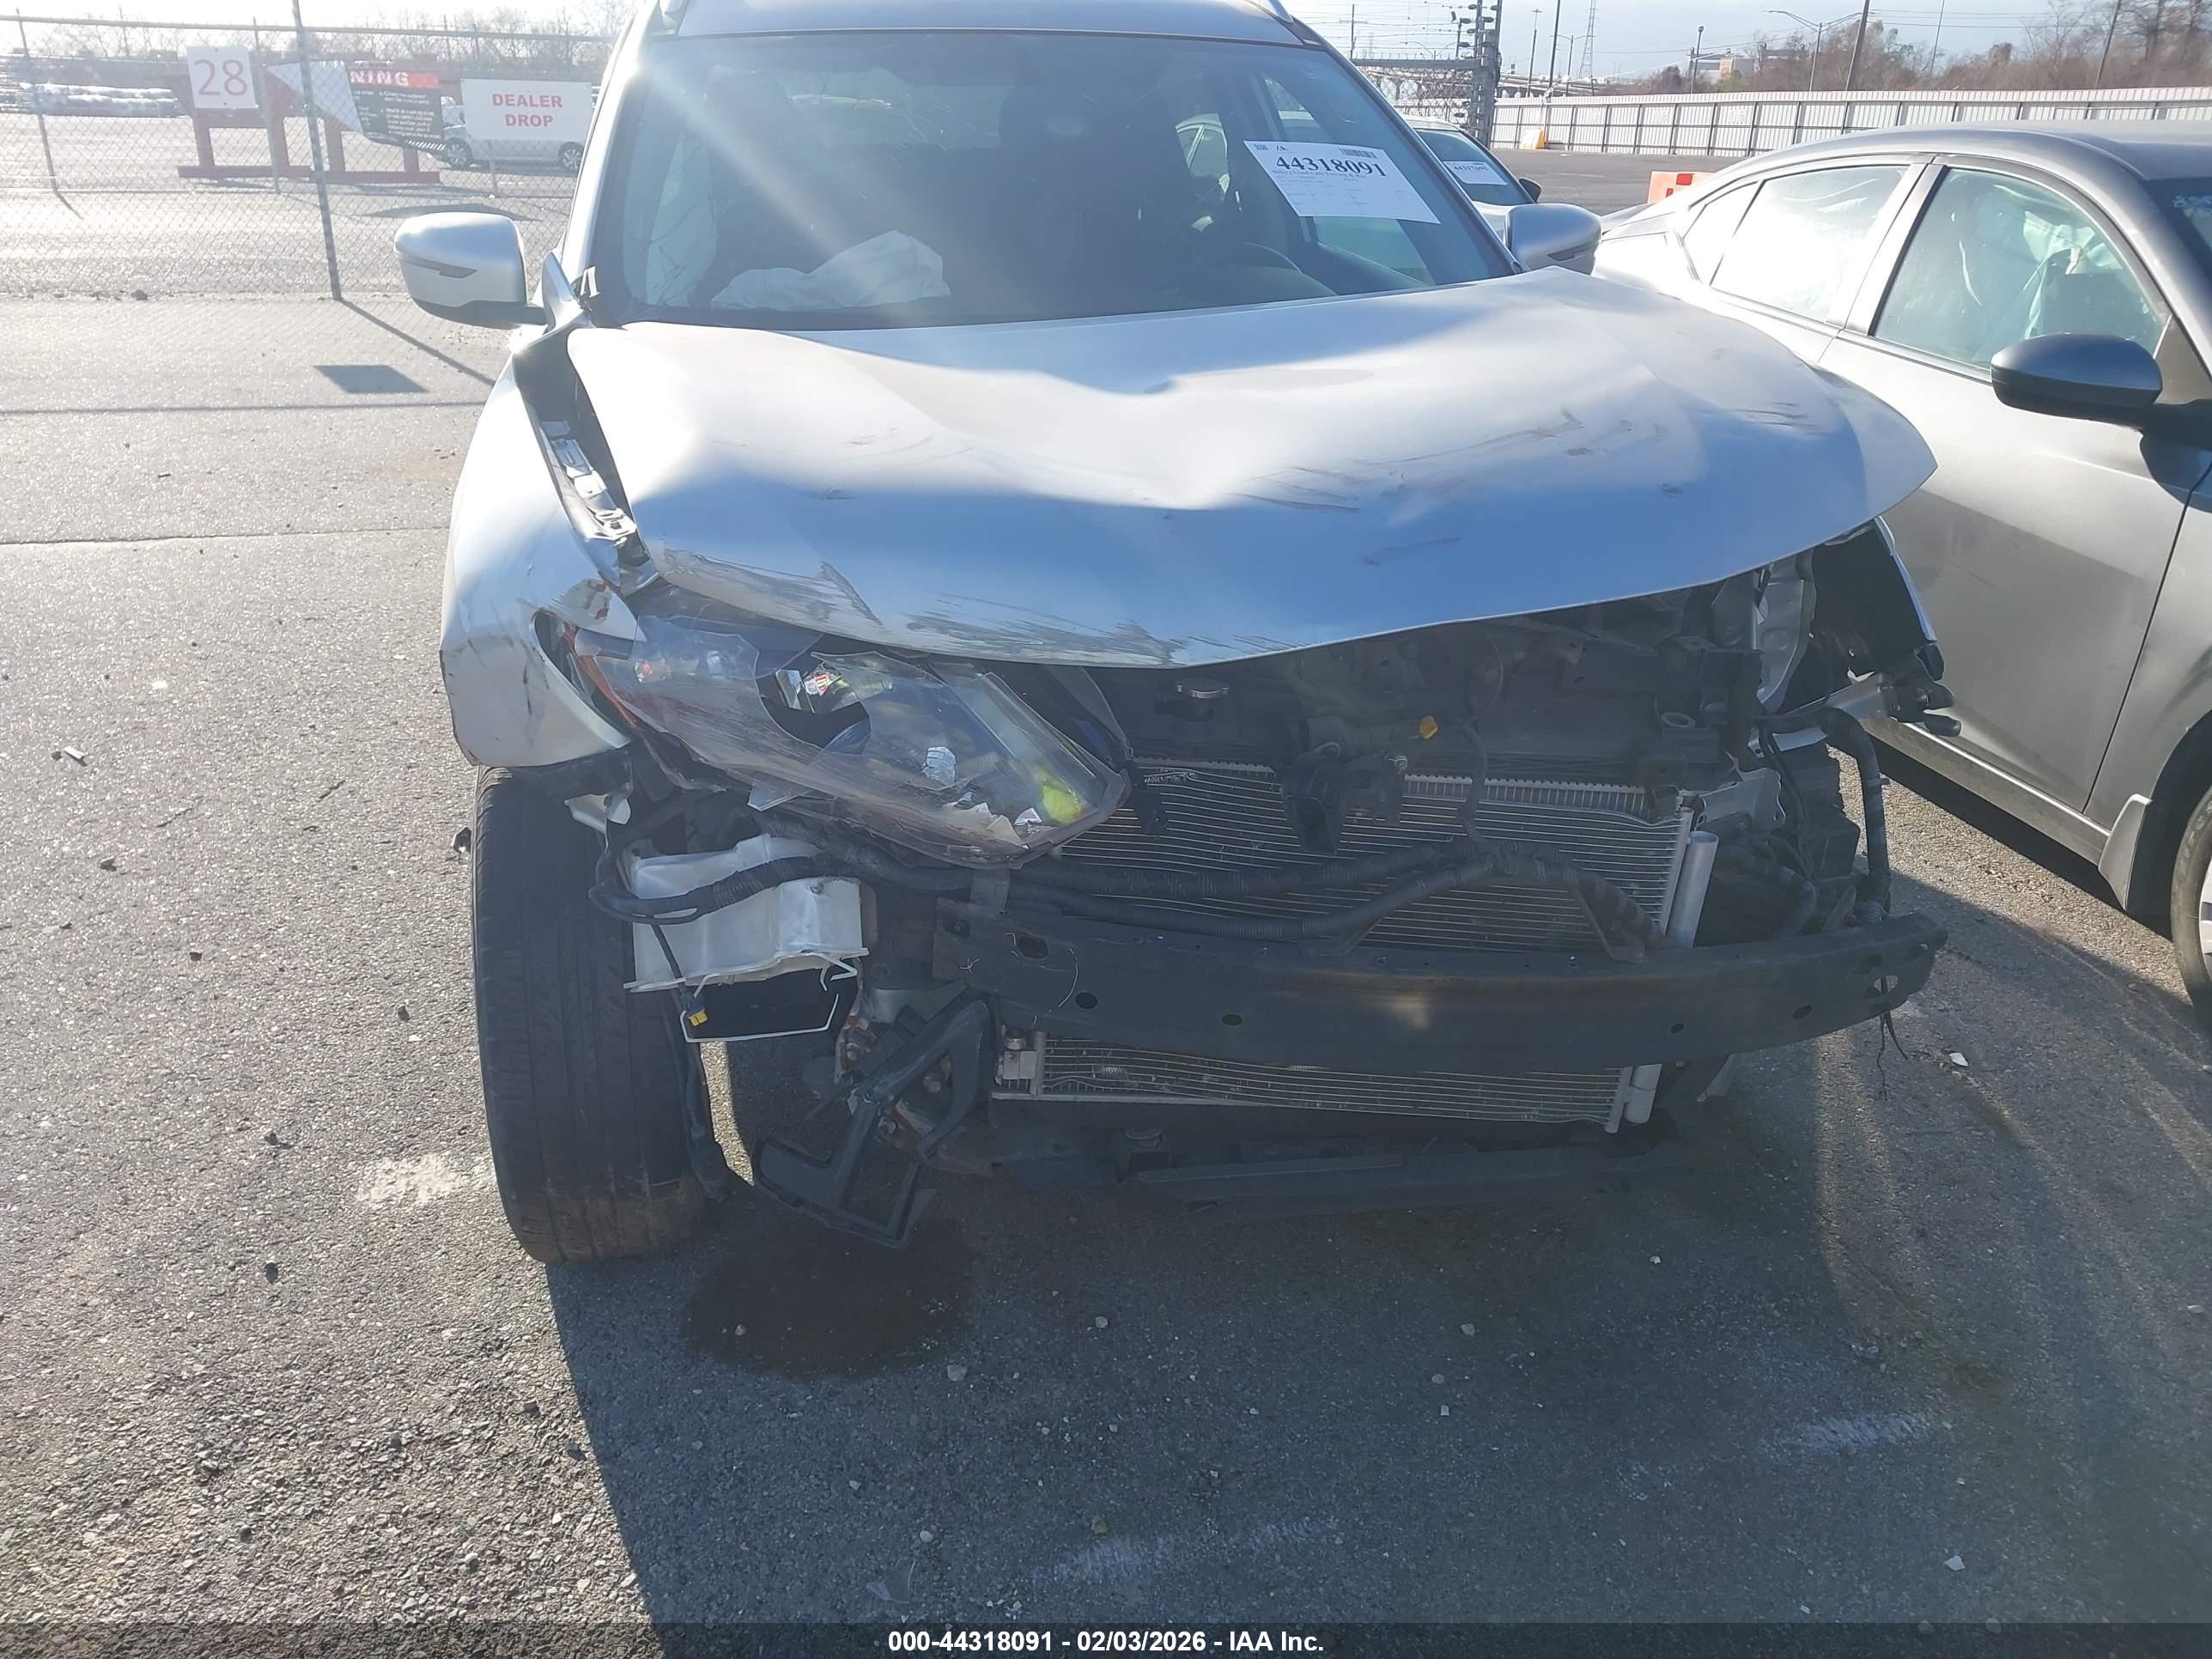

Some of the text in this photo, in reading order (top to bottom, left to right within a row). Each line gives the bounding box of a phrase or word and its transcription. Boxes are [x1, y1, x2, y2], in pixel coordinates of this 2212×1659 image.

[193, 59, 247, 96] 28
[349, 70, 409, 86] NING
[492, 93, 563, 108] DEALER
[505, 113, 554, 127] DROP
[1276, 156, 1388, 177] 44318091
